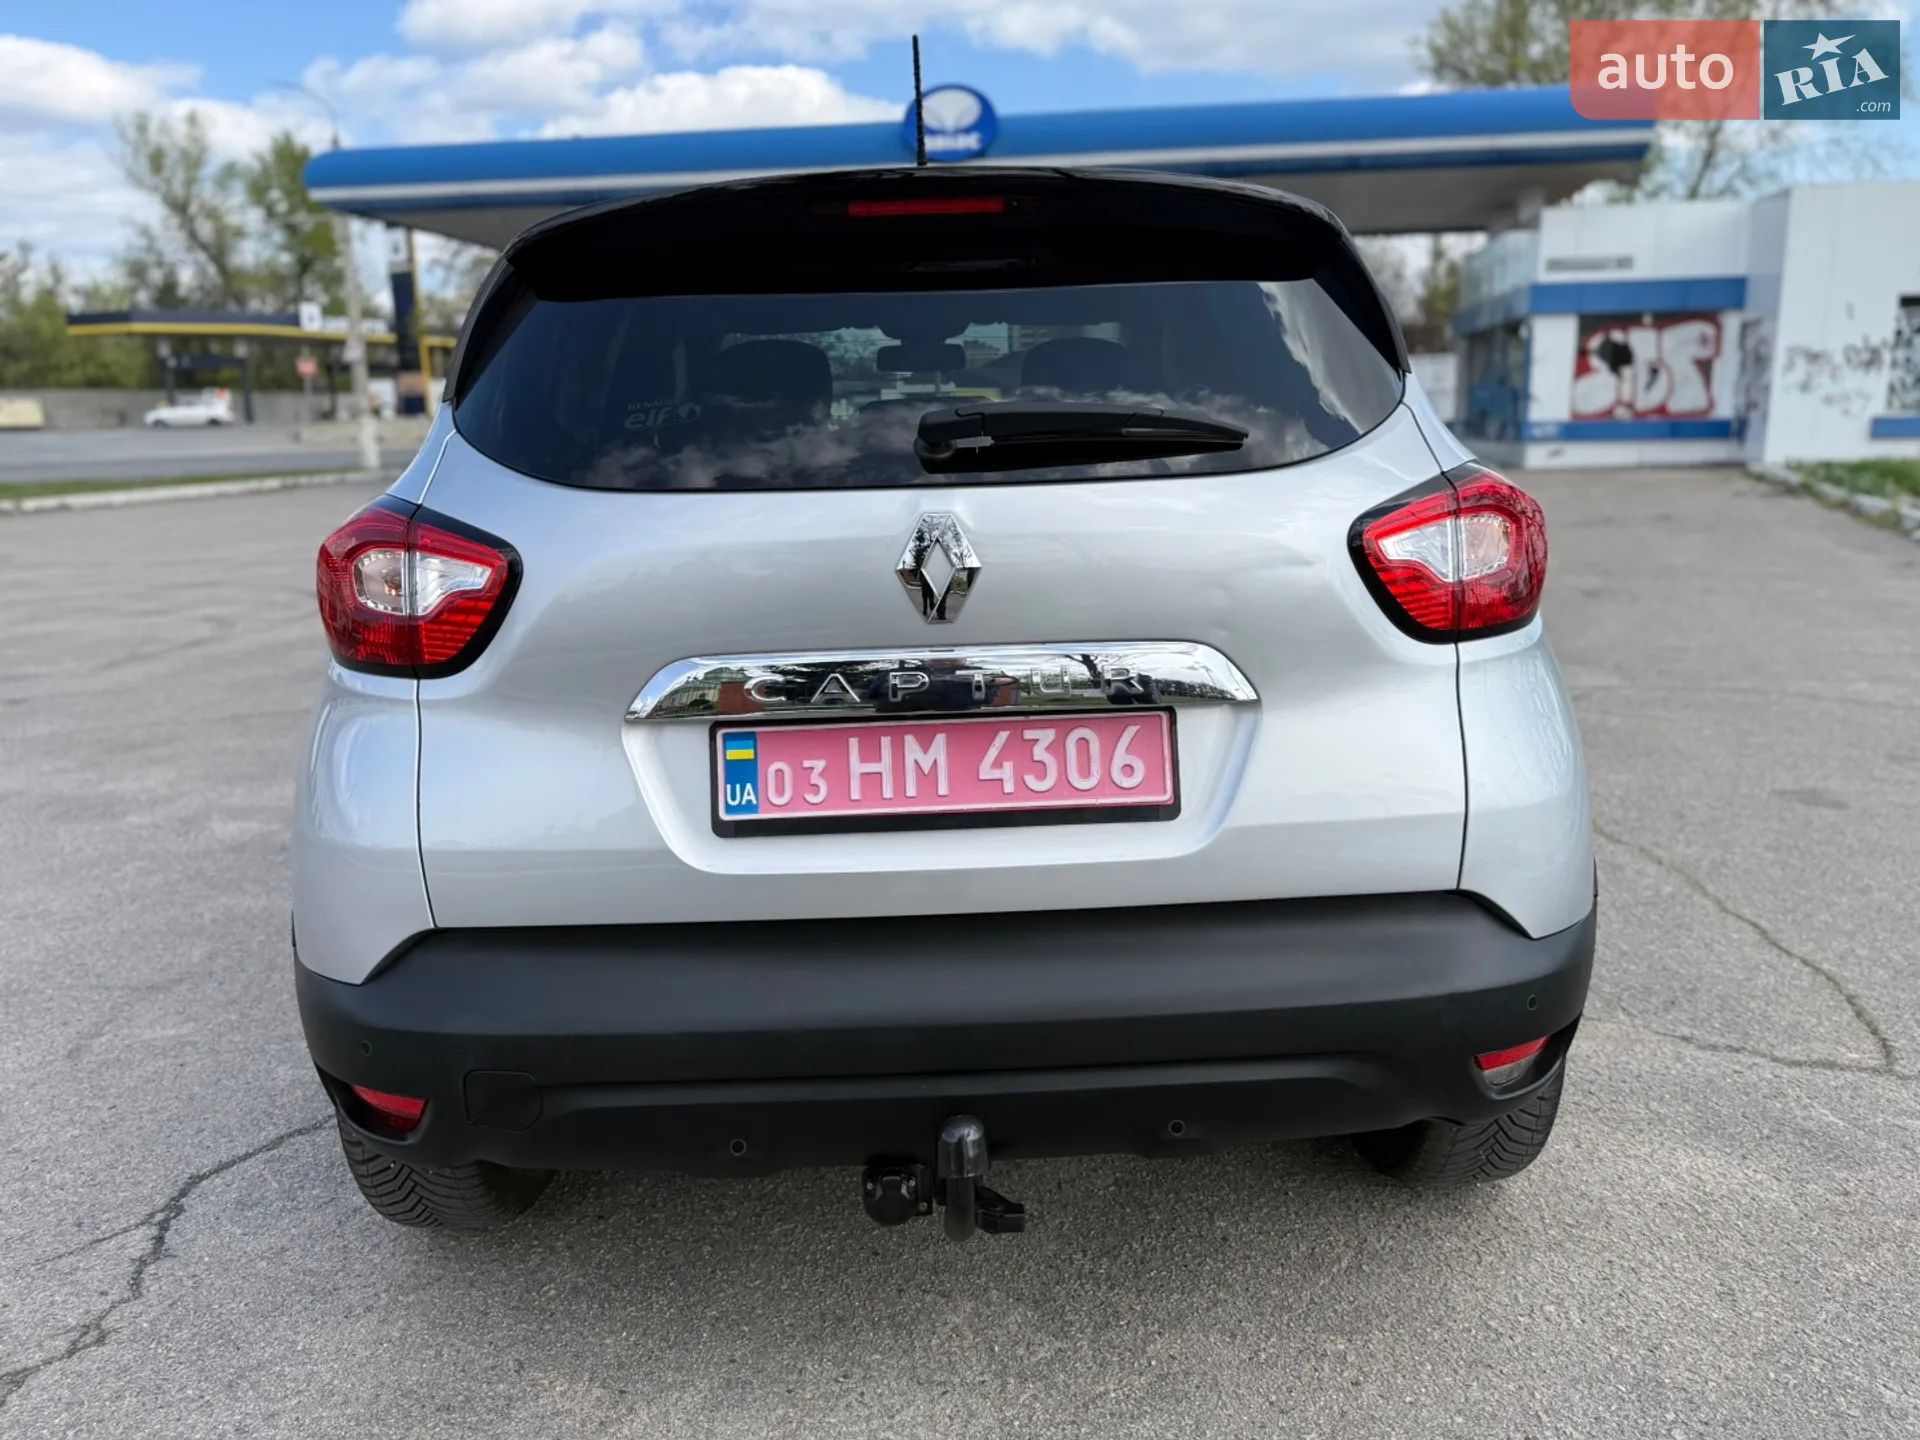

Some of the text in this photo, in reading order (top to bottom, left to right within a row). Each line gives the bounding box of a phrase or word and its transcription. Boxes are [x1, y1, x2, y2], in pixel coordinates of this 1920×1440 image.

[743, 664, 1146, 703] CAPTUR
[766, 724, 1146, 807] 03 HM 4306
[726, 783, 758, 807] UA
